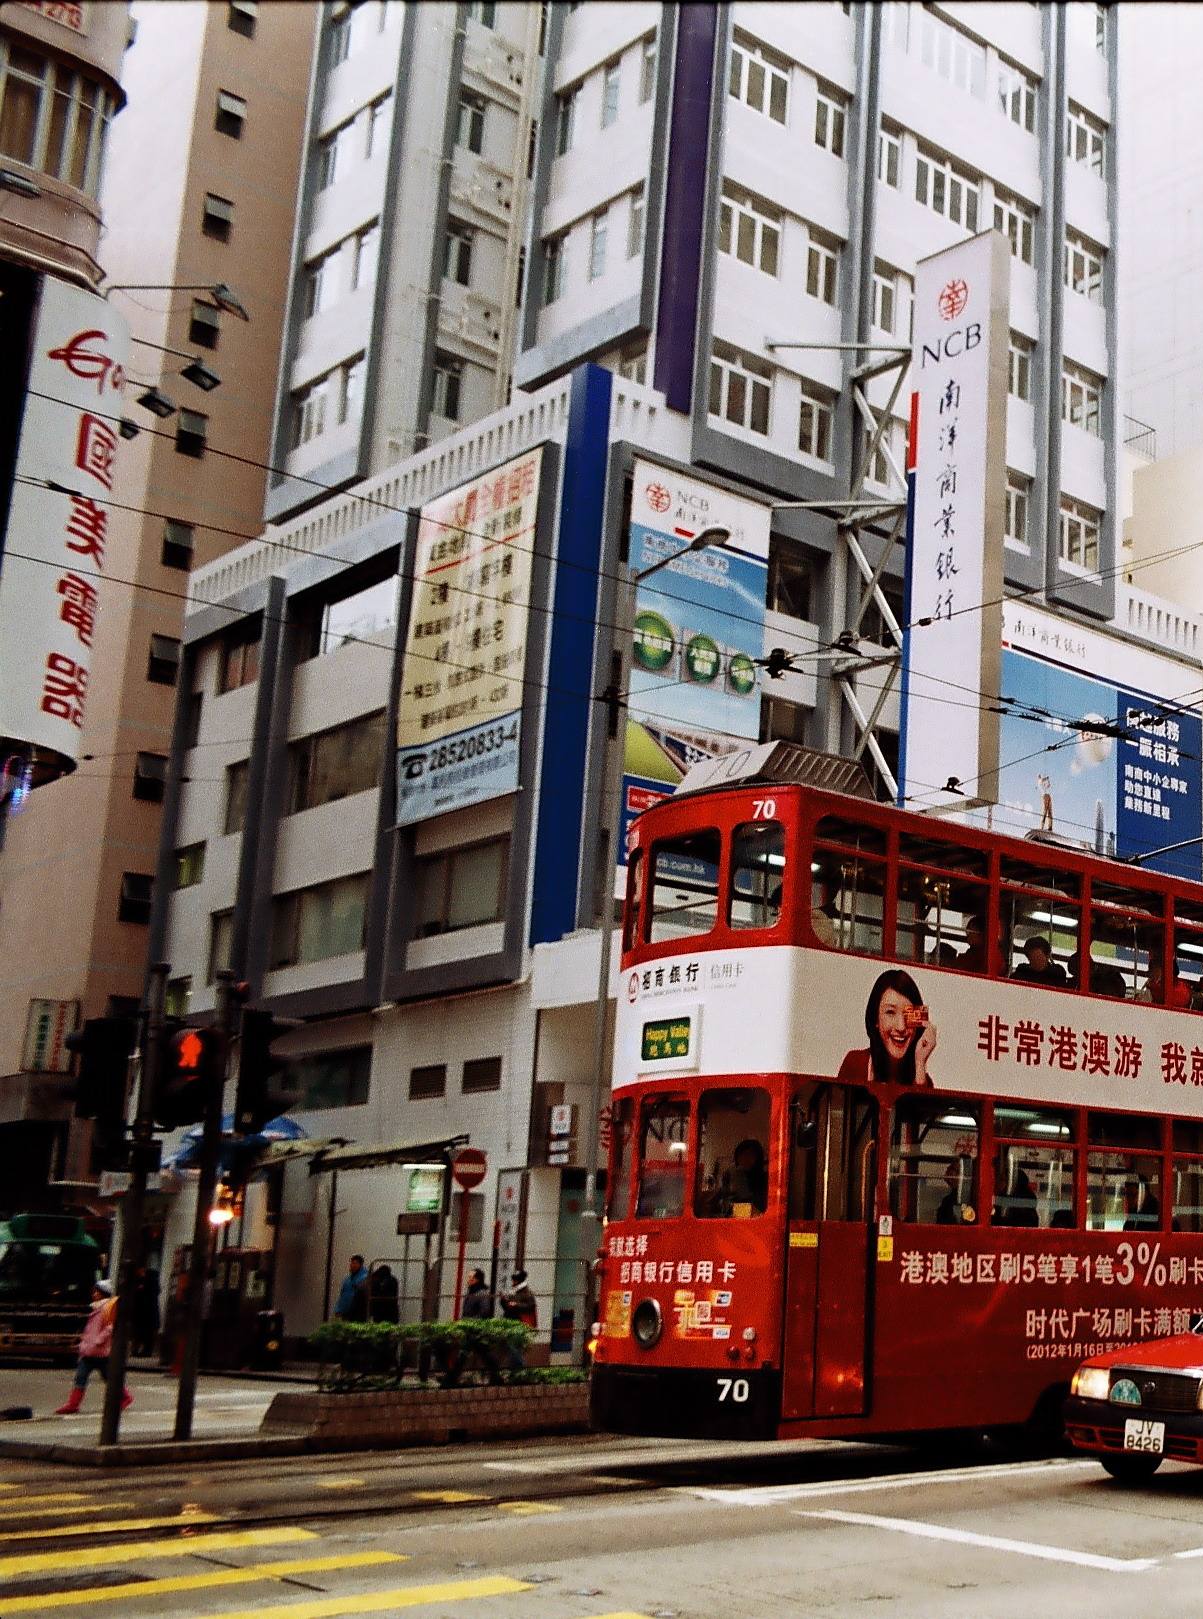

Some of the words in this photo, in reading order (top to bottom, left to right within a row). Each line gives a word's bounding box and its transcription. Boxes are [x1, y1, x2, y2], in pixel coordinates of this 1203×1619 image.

[921, 323, 981, 369] NCB
[933, 379, 962, 622] 南洋商業銀行
[704, 750, 752, 785] 70
[752, 800, 776, 819] 70
[977, 1014, 1143, 1079] 非常港澳游
[620, 1260, 737, 1283] 招商银行信用卡
[716, 1378, 750, 1402] 70
[1136, 1421, 1155, 1435] JV
[1125, 1435, 1161, 1451] 8426
